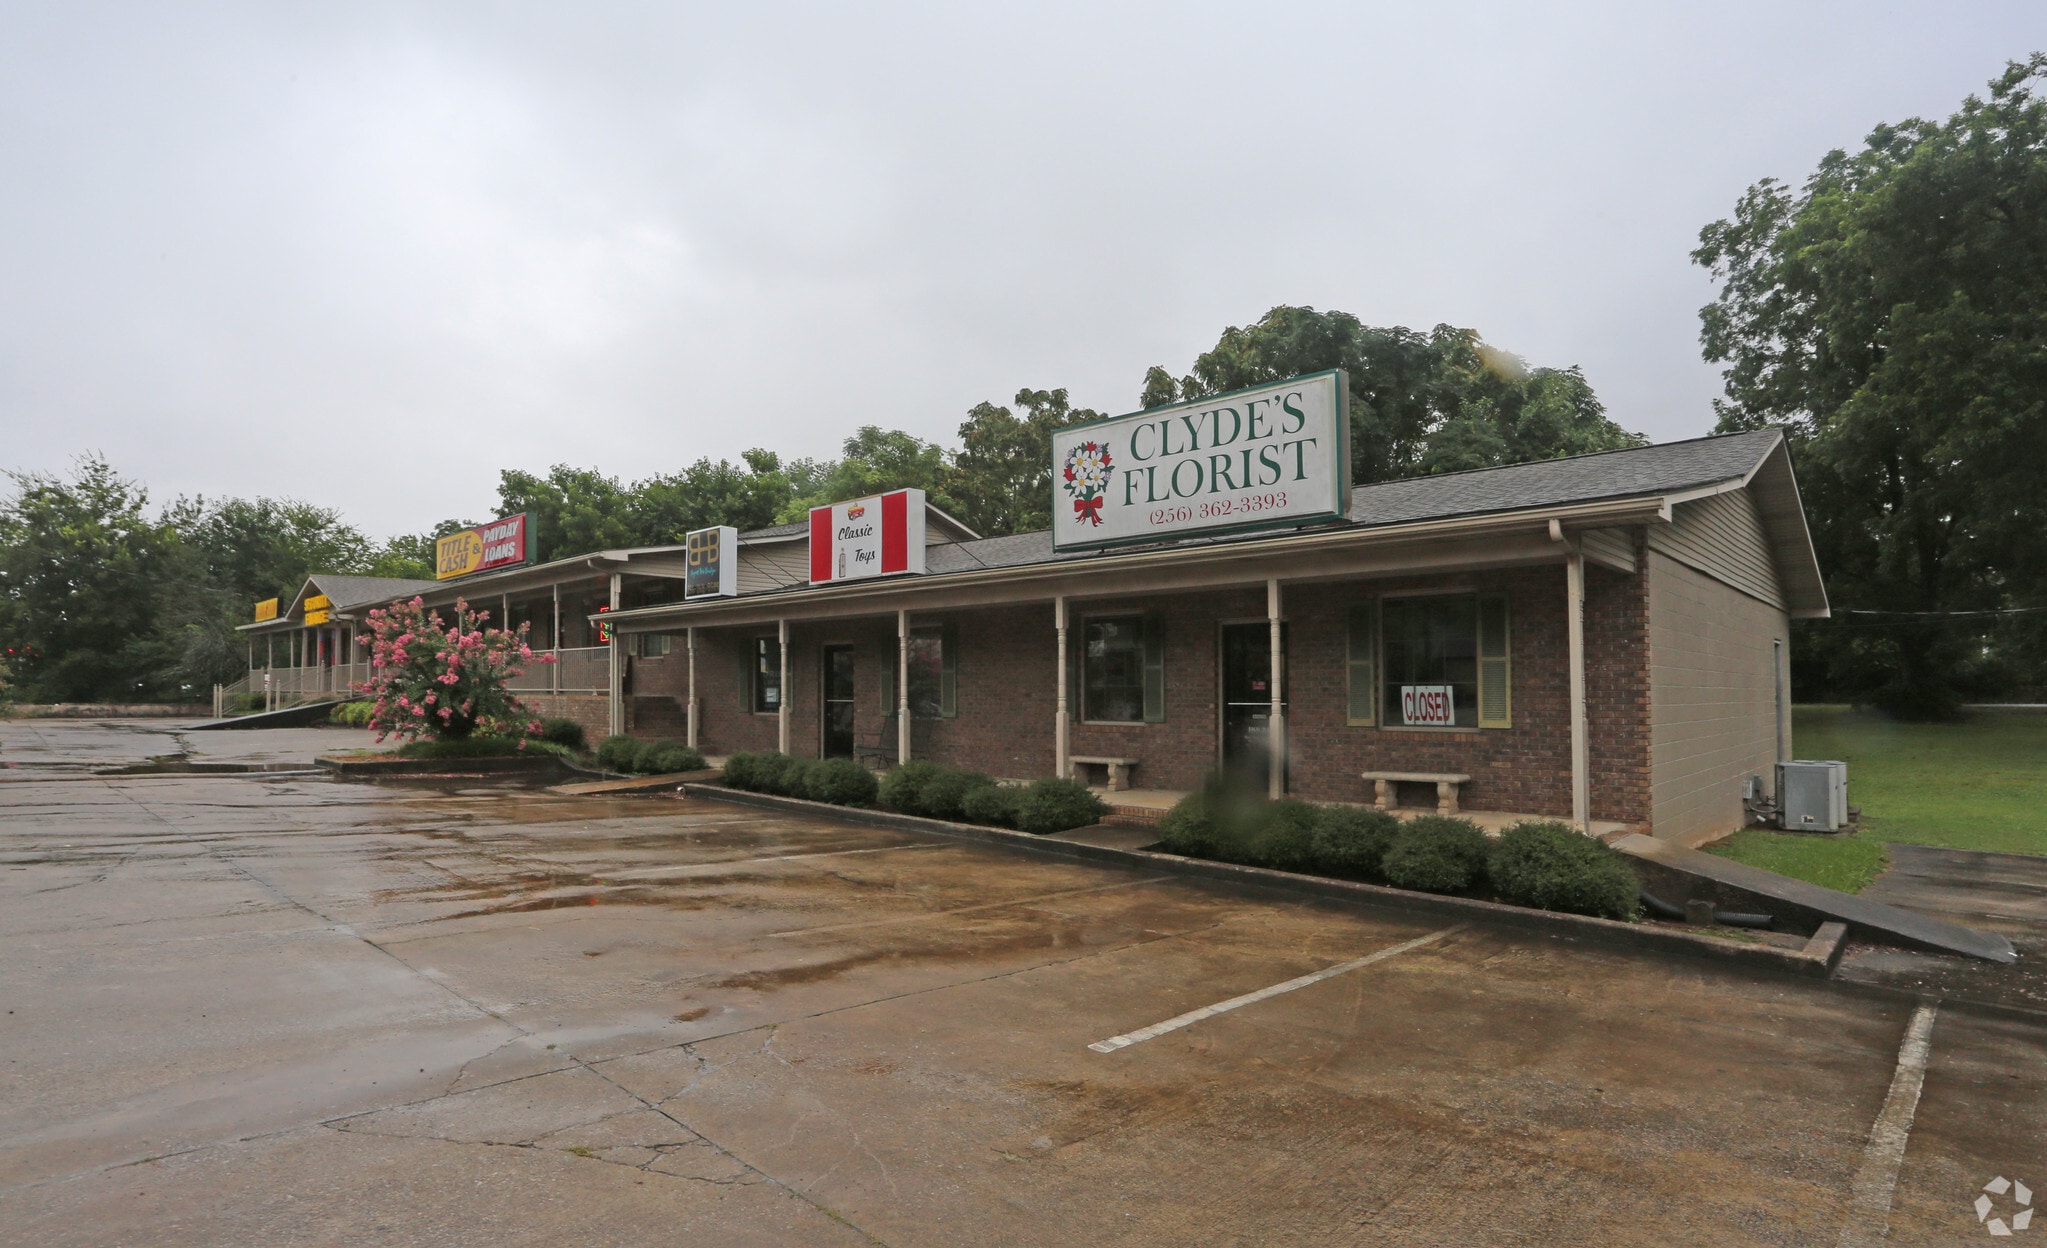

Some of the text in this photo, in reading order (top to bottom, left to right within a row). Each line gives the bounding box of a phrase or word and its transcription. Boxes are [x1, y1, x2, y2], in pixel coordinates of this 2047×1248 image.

[1130, 392, 1305, 461] CLYDE'S
[1122, 438, 1317, 506] FLORIST
[1150, 491, 1288, 526] (256) 362-3393
[483, 521, 519, 544] PAYDAY
[838, 523, 873, 541] Classic
[441, 534, 481, 558] TITLE &
[484, 541, 515, 562] LOANS
[855, 548, 876, 565] Toys
[440, 552, 468, 573] CASH
[1404, 692, 1450, 721] CLOSED
